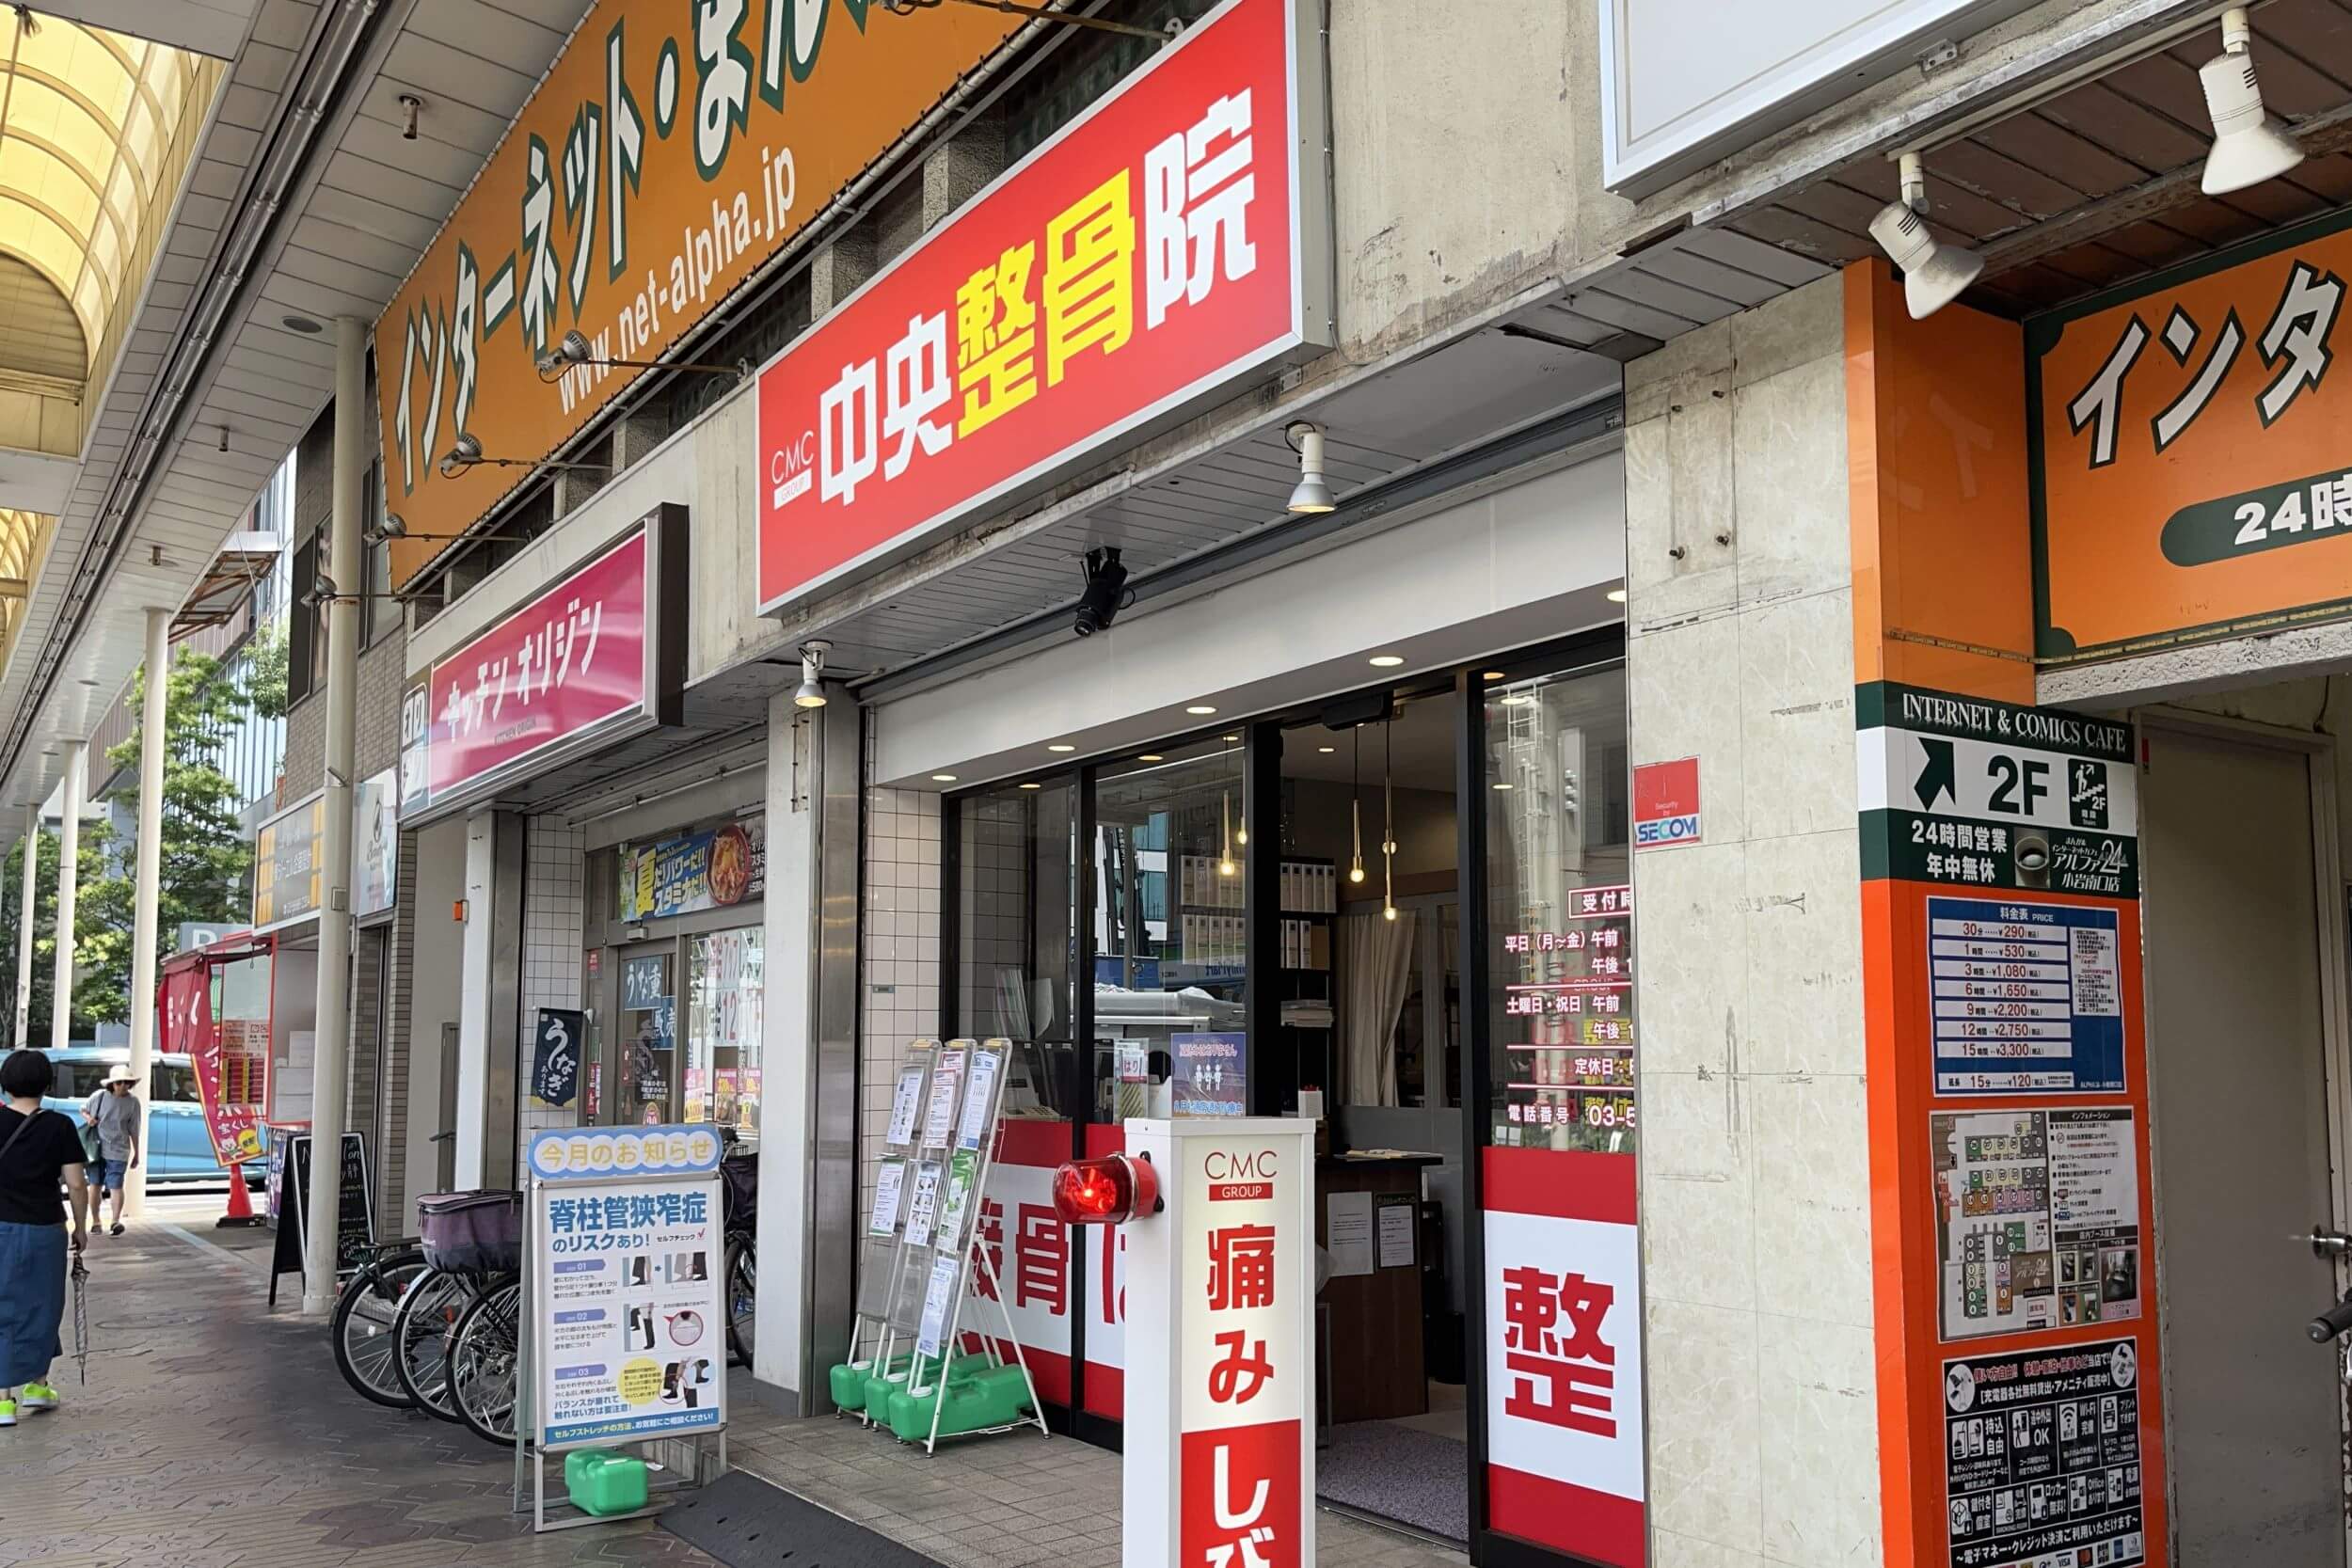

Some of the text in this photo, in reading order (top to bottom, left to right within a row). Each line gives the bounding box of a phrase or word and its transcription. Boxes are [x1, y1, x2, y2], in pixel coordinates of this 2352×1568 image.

[559, 146, 795, 416] www.net-alpha.jp
[819, 87, 1258, 507] 中央整骨院
[2067, 259, 2348, 470] インタ
[771, 430, 814, 484] CMC
[1903, 693, 2126, 751] INTERNET & COMICS CAFE
[1987, 754, 2050, 816] 2F
[2091, 797, 2106, 810] 2F
[1639, 816, 1697, 843] SECOM
[1912, 820, 2008, 853] 24時間営業
[1927, 852, 1995, 882] 年中無休
[2061, 872, 2121, 893] 小岩南口店
[2000, 907, 2054, 923] 料金表 PRICE
[1591, 929, 1618, 947] 午前
[1592, 957, 1619, 974] 午後
[627, 963, 661, 1003] うな重
[1506, 995, 1619, 1014] 土曜日・祝日 午前
[1593, 1022, 1620, 1039] 午後
[545, 1018, 577, 1098] うなぎ
[1508, 1104, 1569, 1123] 電話番号
[541, 1138, 712, 1168] 今月のお知らせ
[1204, 1150, 1278, 1180] CMC
[1221, 1184, 1263, 1199] GROUP
[549, 1192, 708, 1234] 脊柱管狭窄症
[657, 1233, 696, 1243] セルフチェック
[1206, 1224, 1276, 1405] 痛み
[1502, 1266, 1617, 1439] 整
[1985, 1417, 2004, 1435] 持込
[2033, 1428, 2050, 1447] OK
[1986, 1437, 2004, 1456] 自由
